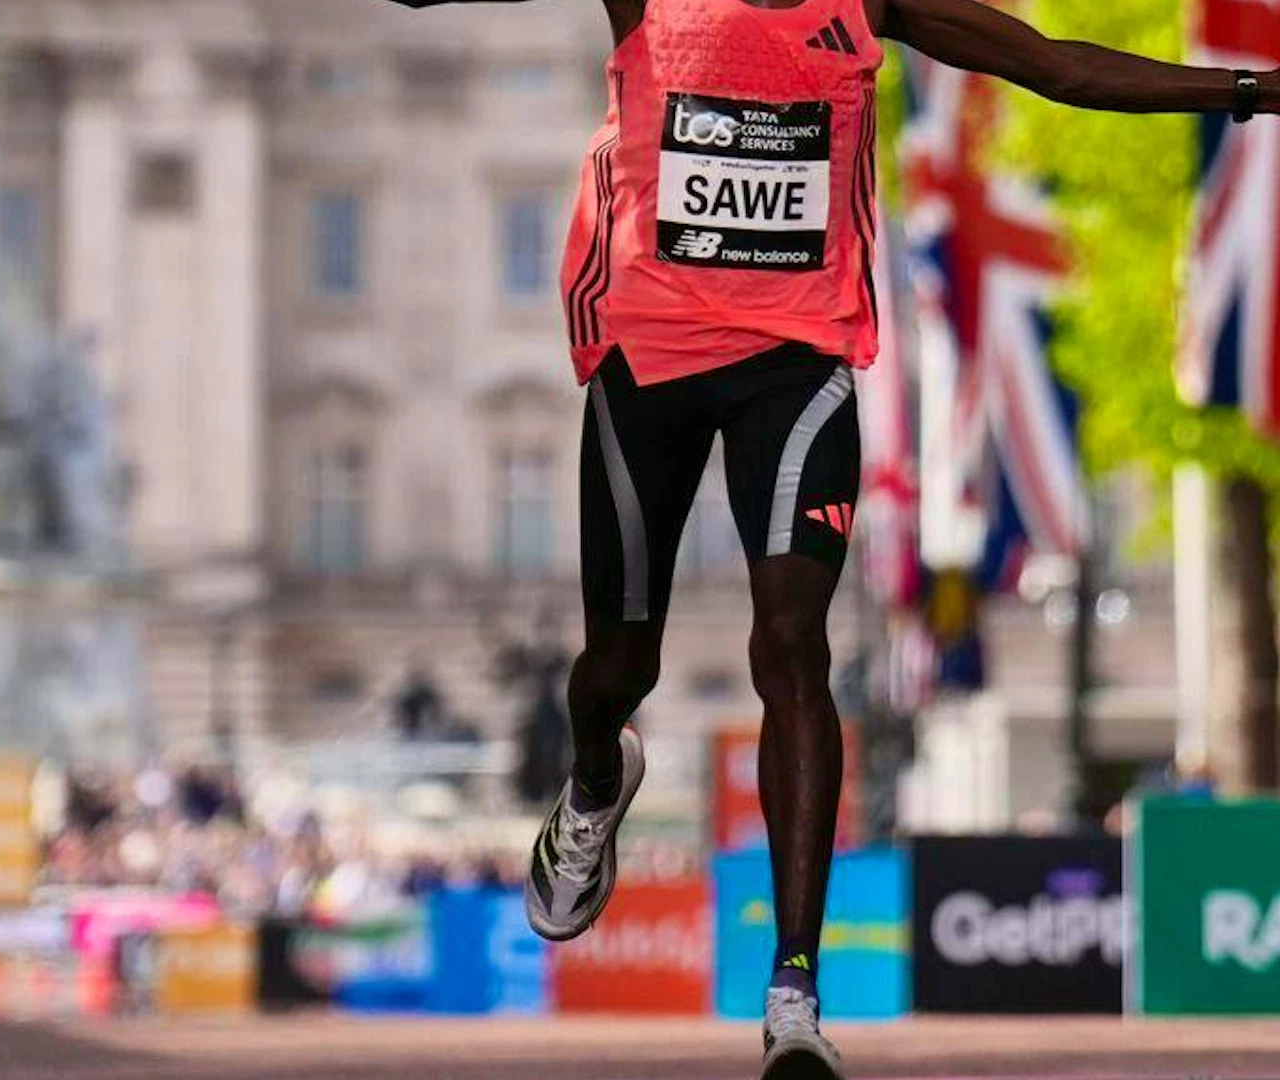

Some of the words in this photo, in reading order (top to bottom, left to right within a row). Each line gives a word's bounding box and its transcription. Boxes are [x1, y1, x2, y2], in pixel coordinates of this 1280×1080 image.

[741, 109, 778, 124] TATA
[673, 102, 740, 148] tcs
[740, 124, 821, 138] CONSULTANCY
[739, 138, 796, 152] SERVICES
[683, 174, 806, 220] SAWE
[721, 248, 752, 261] new
[753, 248, 810, 264] balance
